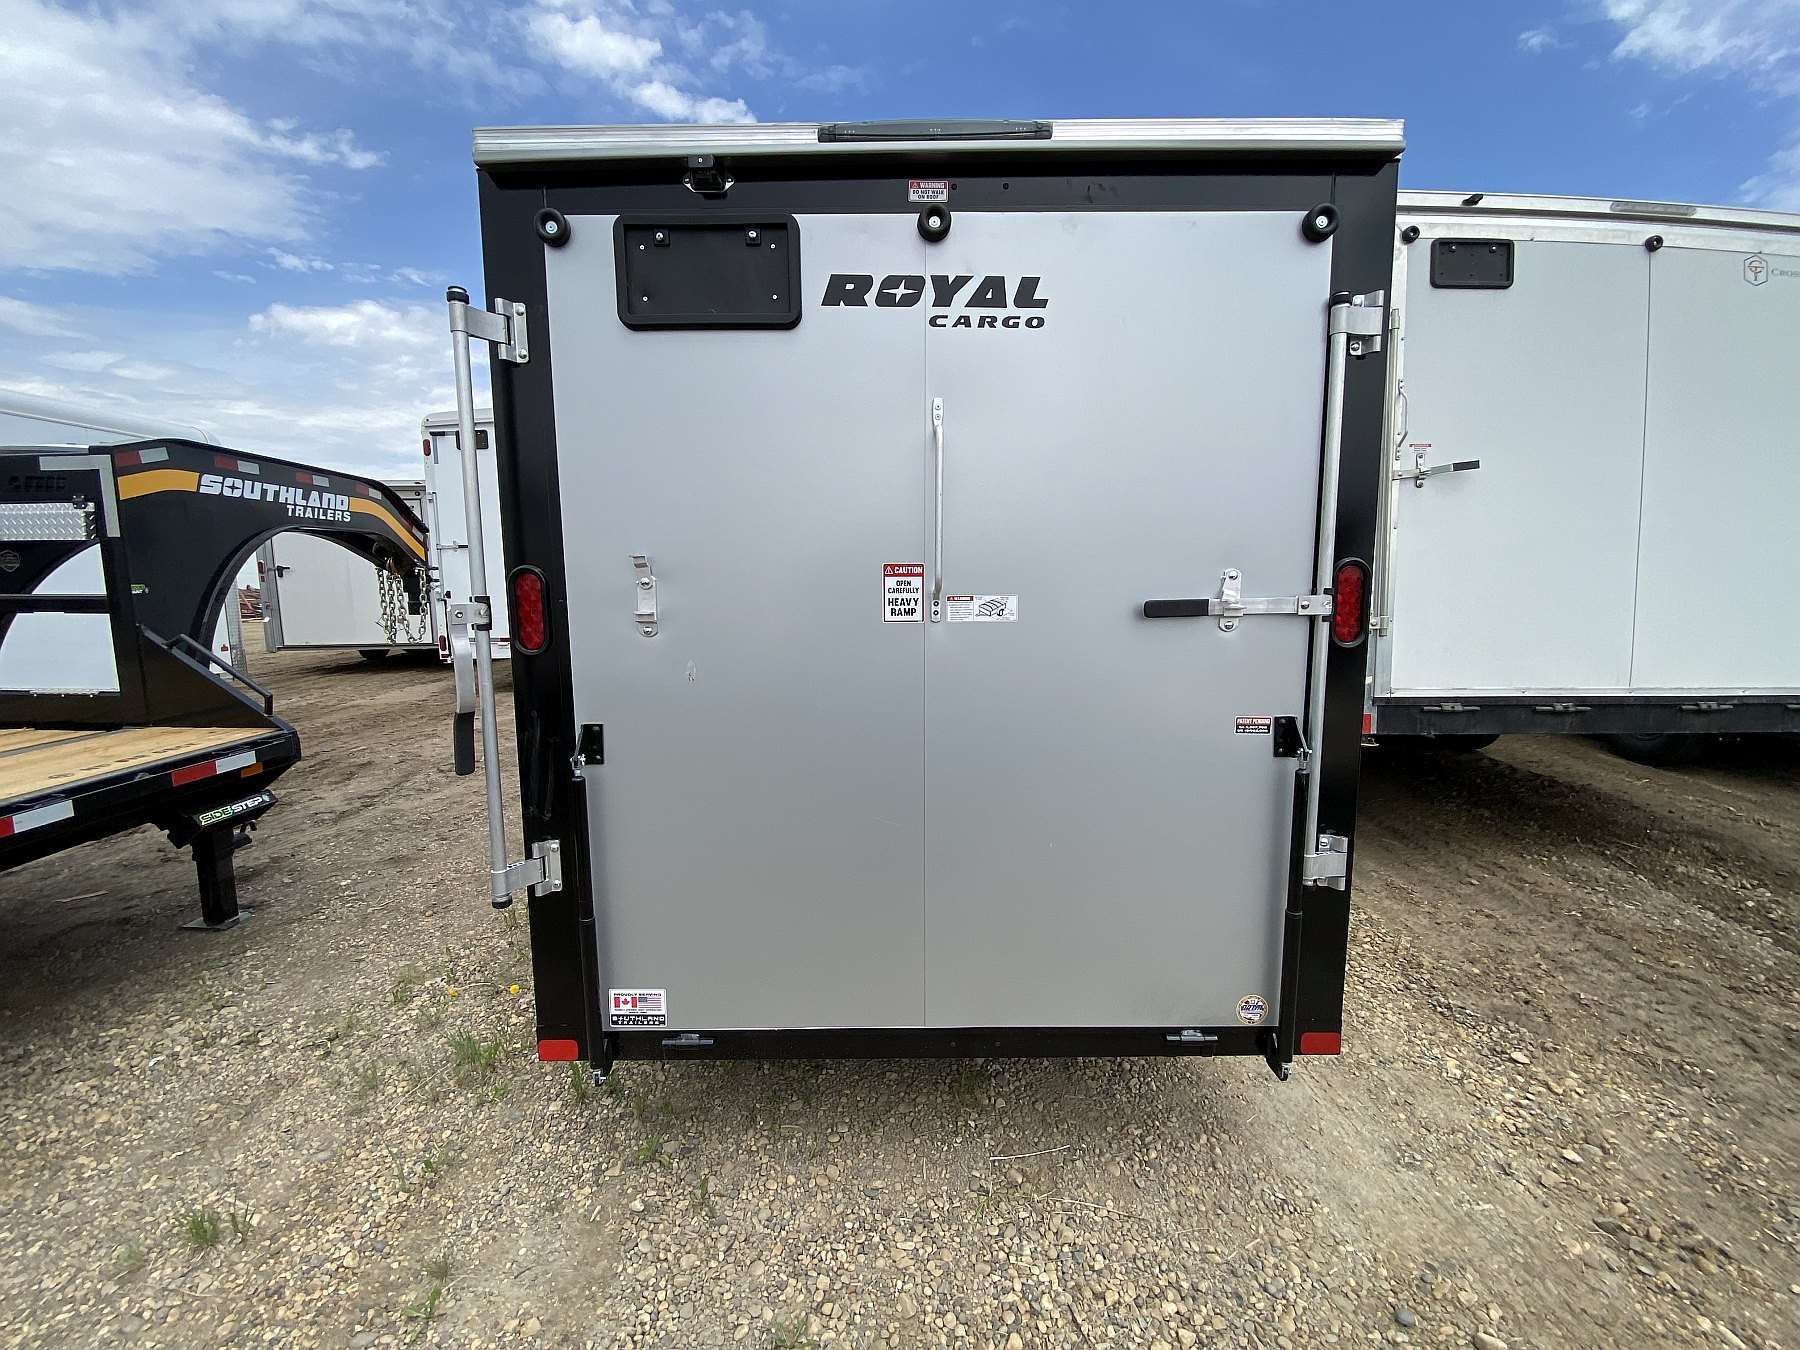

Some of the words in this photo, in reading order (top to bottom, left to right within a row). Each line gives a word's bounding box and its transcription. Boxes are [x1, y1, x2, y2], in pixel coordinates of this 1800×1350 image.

[821, 273, 1049, 309] ROYAL
[928, 314, 1046, 329] CARGO
[199, 473, 350, 511] SOUTHLAND
[286, 504, 351, 523] TRAILERS
[894, 566, 923, 574] CAUTION
[887, 597, 920, 607] HEAVY
[890, 607, 917, 617] RAMP
